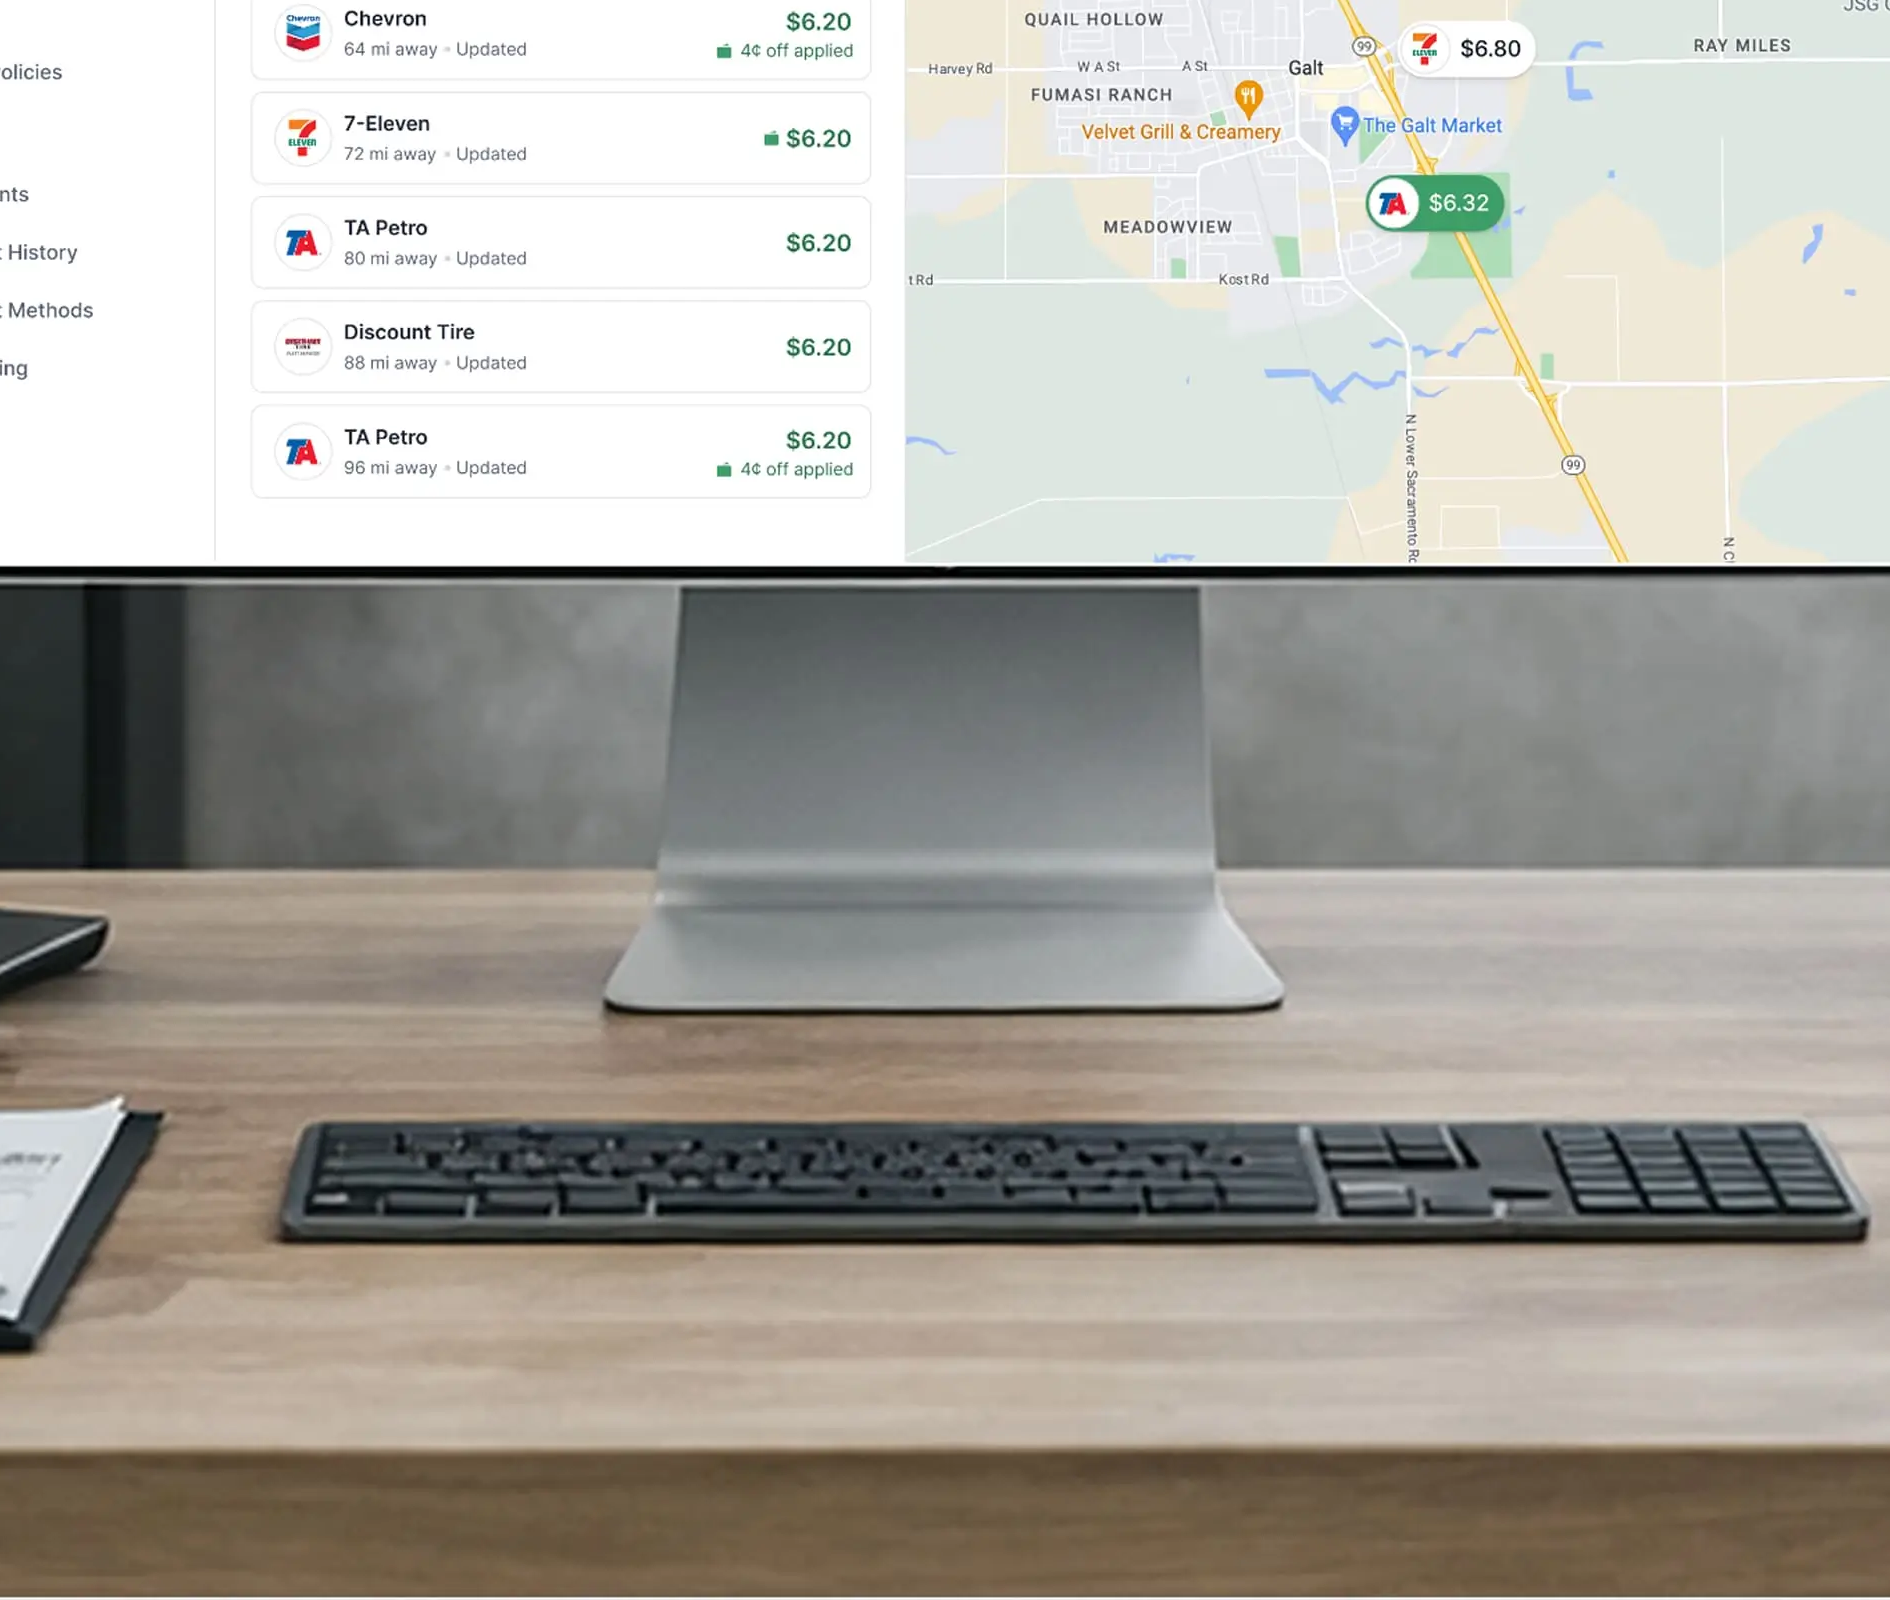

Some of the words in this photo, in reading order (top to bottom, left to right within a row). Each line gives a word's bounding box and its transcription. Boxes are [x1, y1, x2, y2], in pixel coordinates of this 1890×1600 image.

[344, 9, 427, 28] Chevron
[786, 10, 852, 33] $6.20
[1024, 12, 1079, 28] QUAIL
[1087, 12, 1163, 26] HOLLOW
[766, 42, 790, 58] off
[794, 43, 854, 61] applied
[1460, 37, 1522, 59] $6.80
[1694, 38, 1728, 53] RAY
[1735, 38, 1791, 53] MILES
[1288, 59, 1324, 76] Galt
[1031, 87, 1101, 102] FUMASI
[1108, 87, 1172, 102] RANCH
[343, 114, 430, 132] 7-Eleven
[1364, 117, 1396, 133] The
[1402, 119, 1436, 133] Galt
[1442, 118, 1502, 133] Market
[786, 127, 852, 149] $6.20
[1081, 123, 1136, 141] Velvet
[1140, 123, 1176, 141] Grill
[1179, 123, 1192, 141] &
[1196, 123, 1282, 145] Creamery
[1429, 192, 1489, 214] $6.32
[343, 218, 371, 236] TA
[375, 218, 428, 237] Petro
[1103, 219, 1232, 234] MEADOWVIEW
[786, 231, 852, 254] $6.20
[8, 243, 78, 265] History
[8, 301, 94, 320] Methods
[344, 322, 432, 341] Discount
[436, 322, 476, 341] Tire
[786, 335, 852, 358] $6.20
[343, 428, 371, 446] TA
[375, 428, 428, 446] Petro
[786, 429, 852, 452] $6.20
[344, 460, 366, 475] 96
[370, 460, 390, 475] mi
[394, 463, 438, 479] away
[456, 460, 527, 478] Updated
